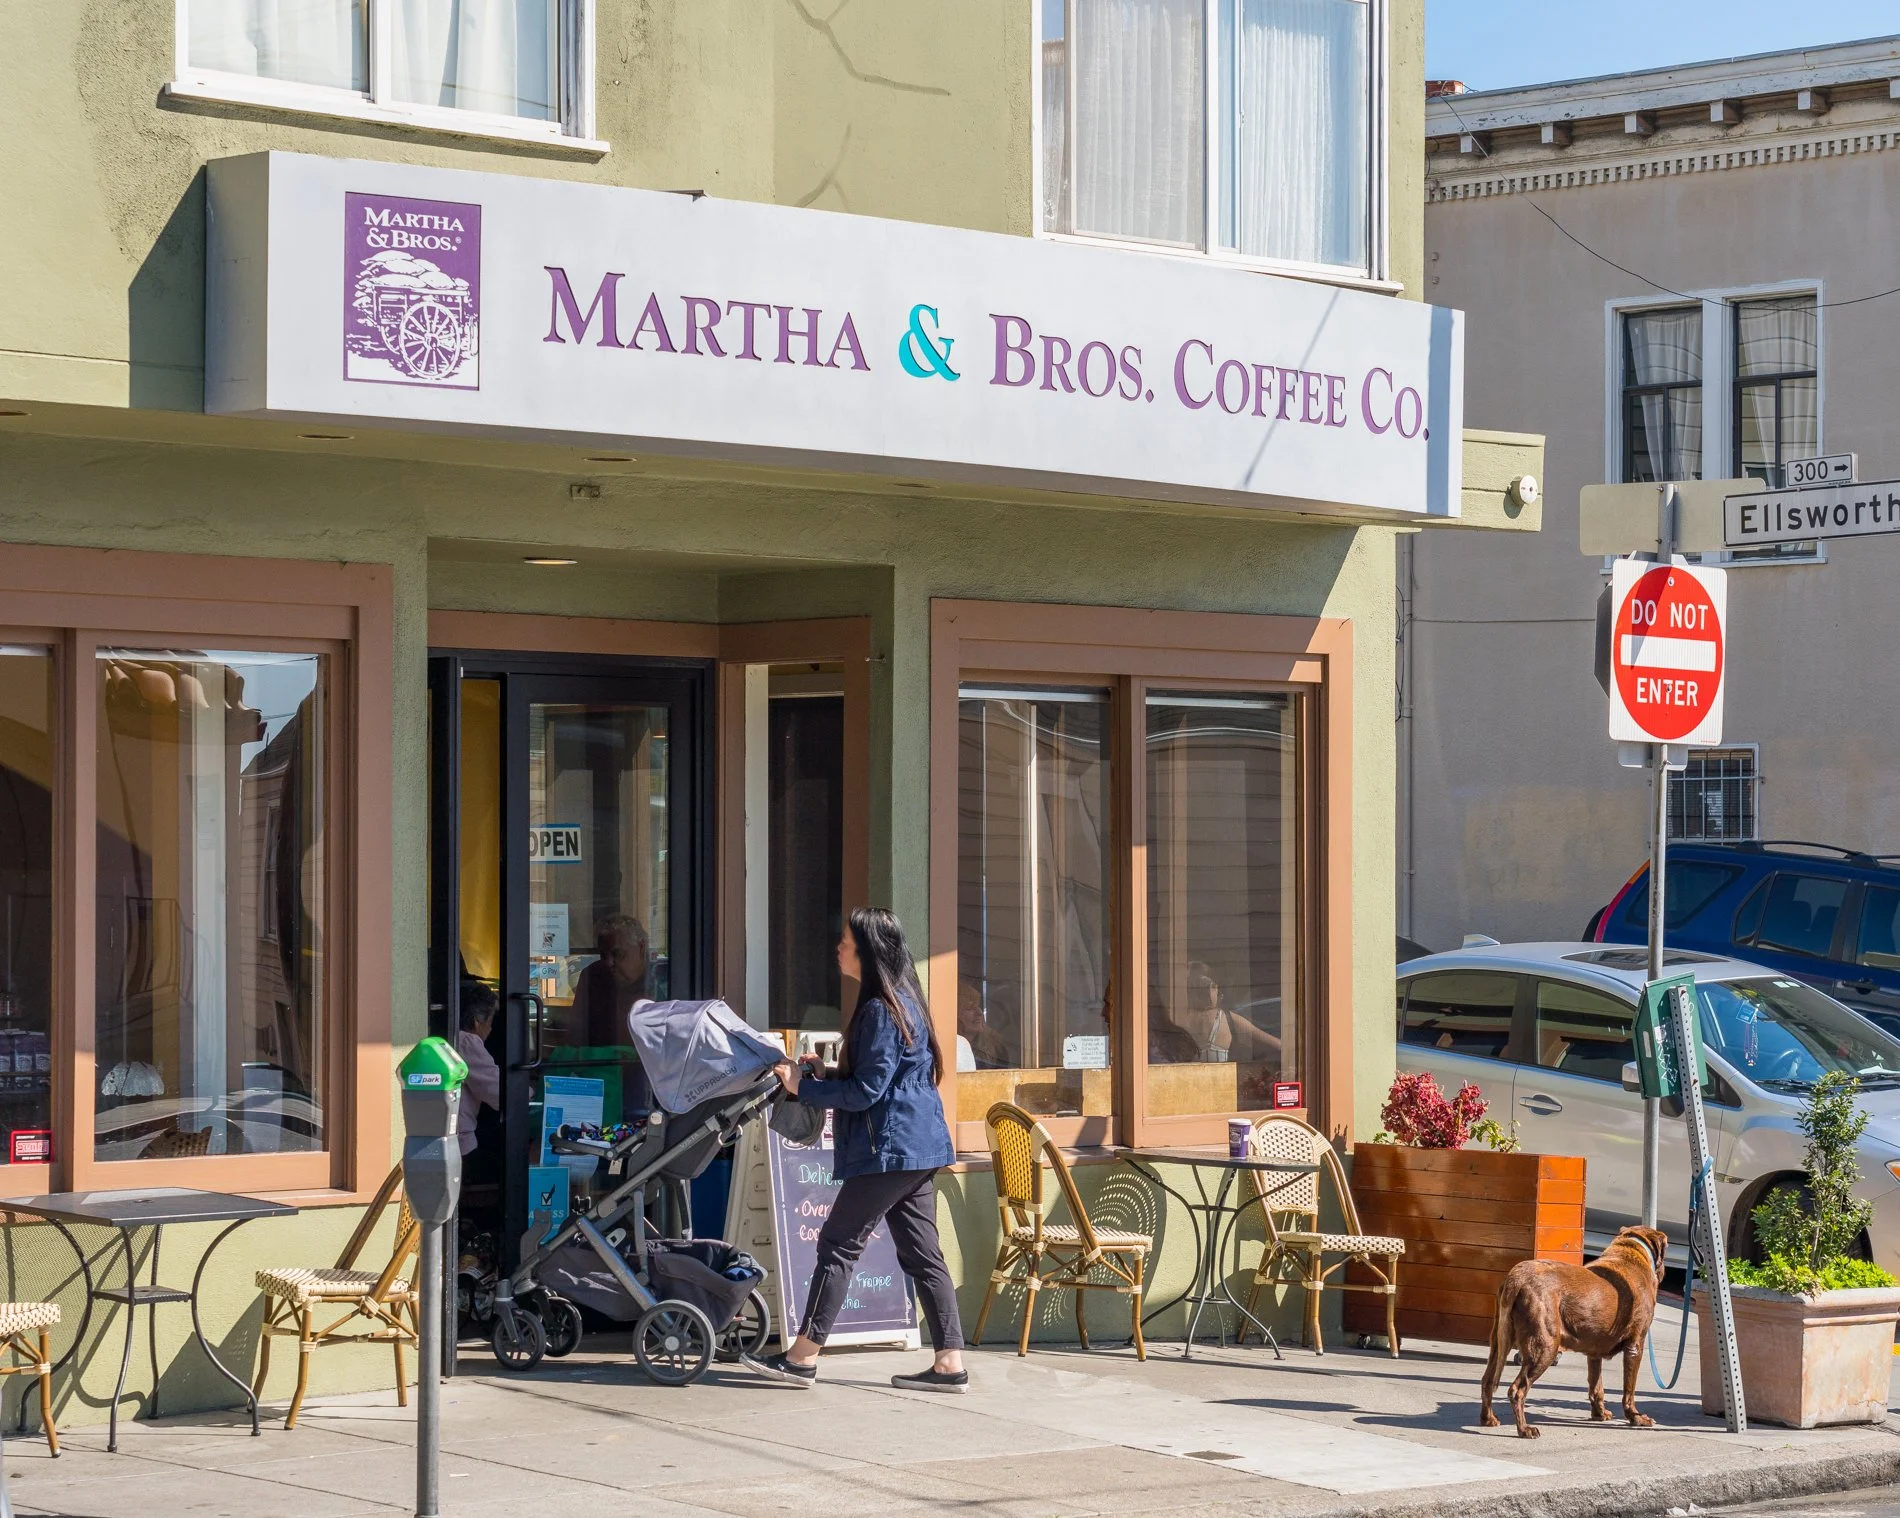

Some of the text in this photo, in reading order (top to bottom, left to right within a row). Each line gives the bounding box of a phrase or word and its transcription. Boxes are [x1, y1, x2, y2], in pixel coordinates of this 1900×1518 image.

[363, 206, 465, 232] MARTHA
[543, 265, 1430, 442] MARTHA & BROS. COFFEE CO.
[1794, 460, 1828, 482] 300
[1740, 492, 1900, 535] Ellsworth
[1631, 599, 1708, 630] DO NOT
[1636, 677, 1698, 707] ENTER
[529, 831, 579, 857] OPEN
